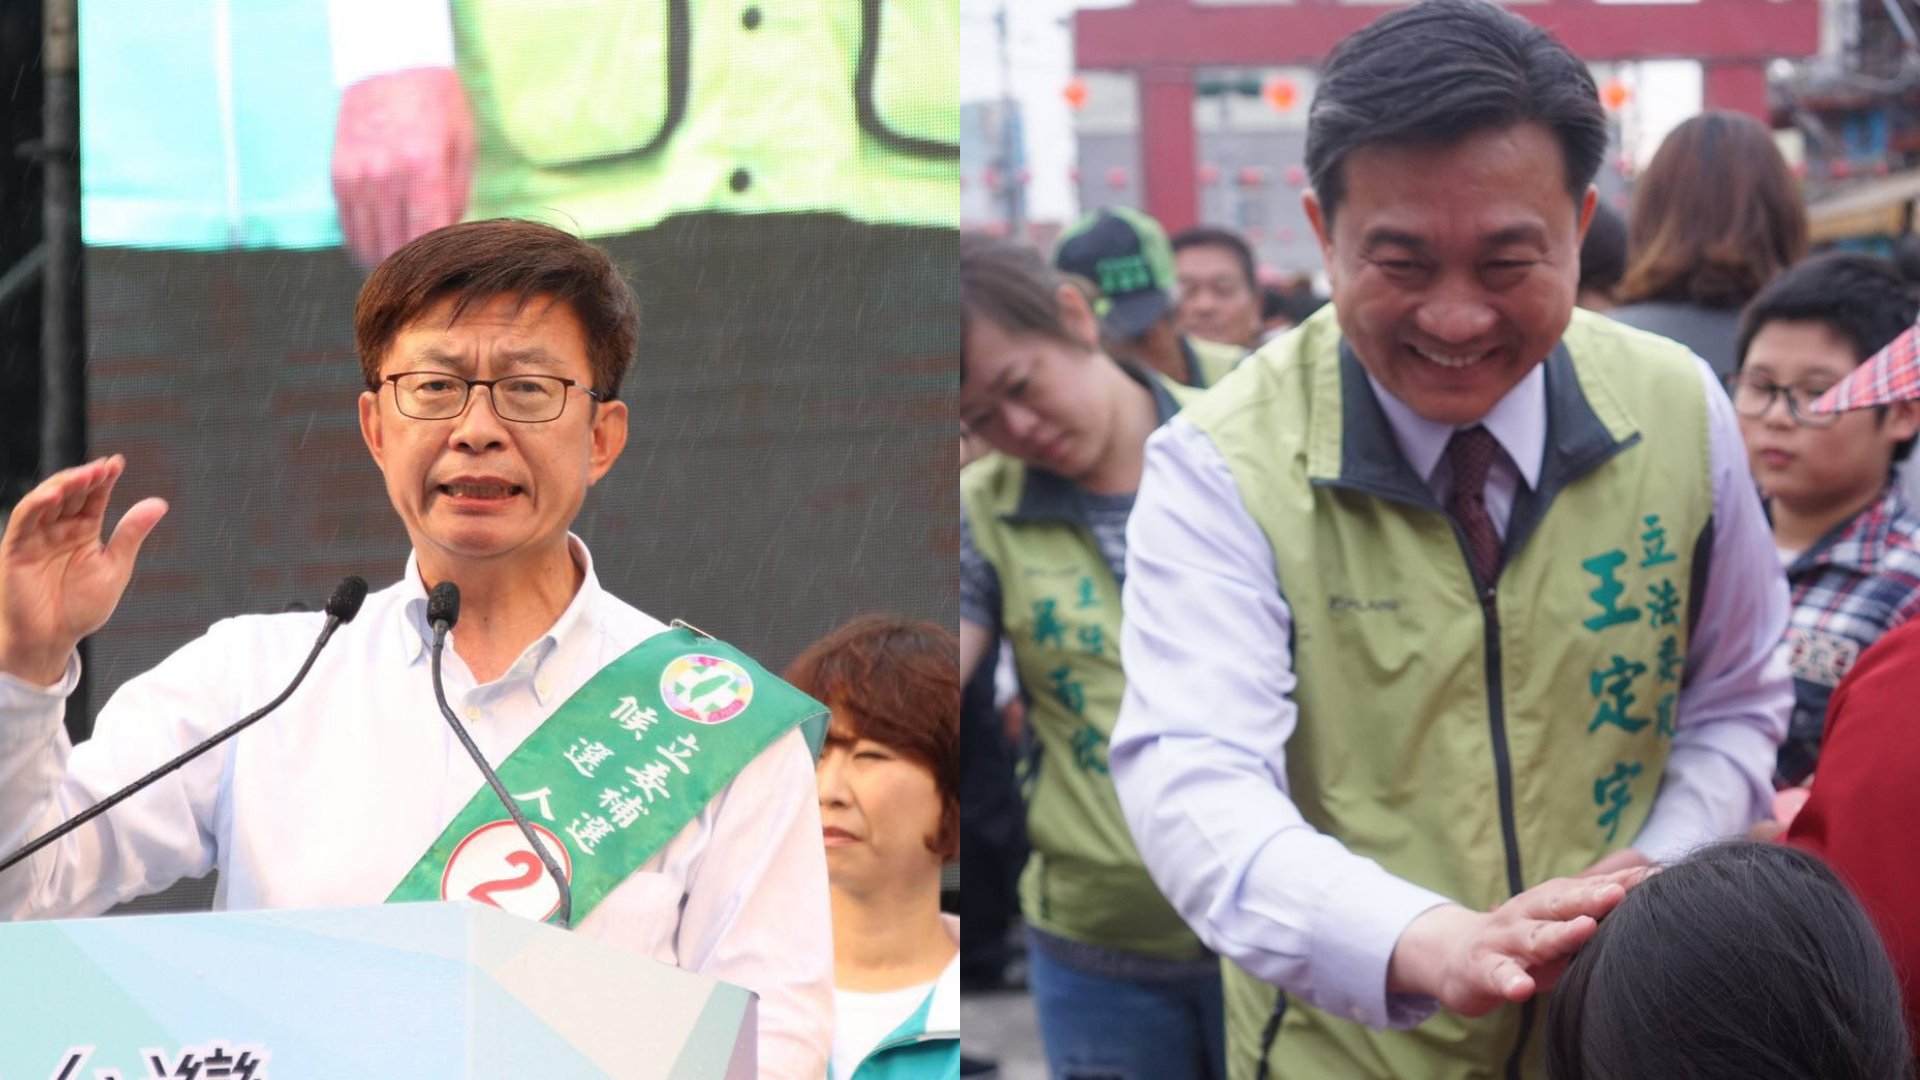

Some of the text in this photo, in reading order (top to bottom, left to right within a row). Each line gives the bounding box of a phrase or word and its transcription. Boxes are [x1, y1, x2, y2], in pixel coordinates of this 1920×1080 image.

[1582, 549, 1651, 843] 王定宇
[513, 696, 658, 821] 候選人
[568, 733, 700, 856] 立委補選
[467, 850, 543, 909] 2
